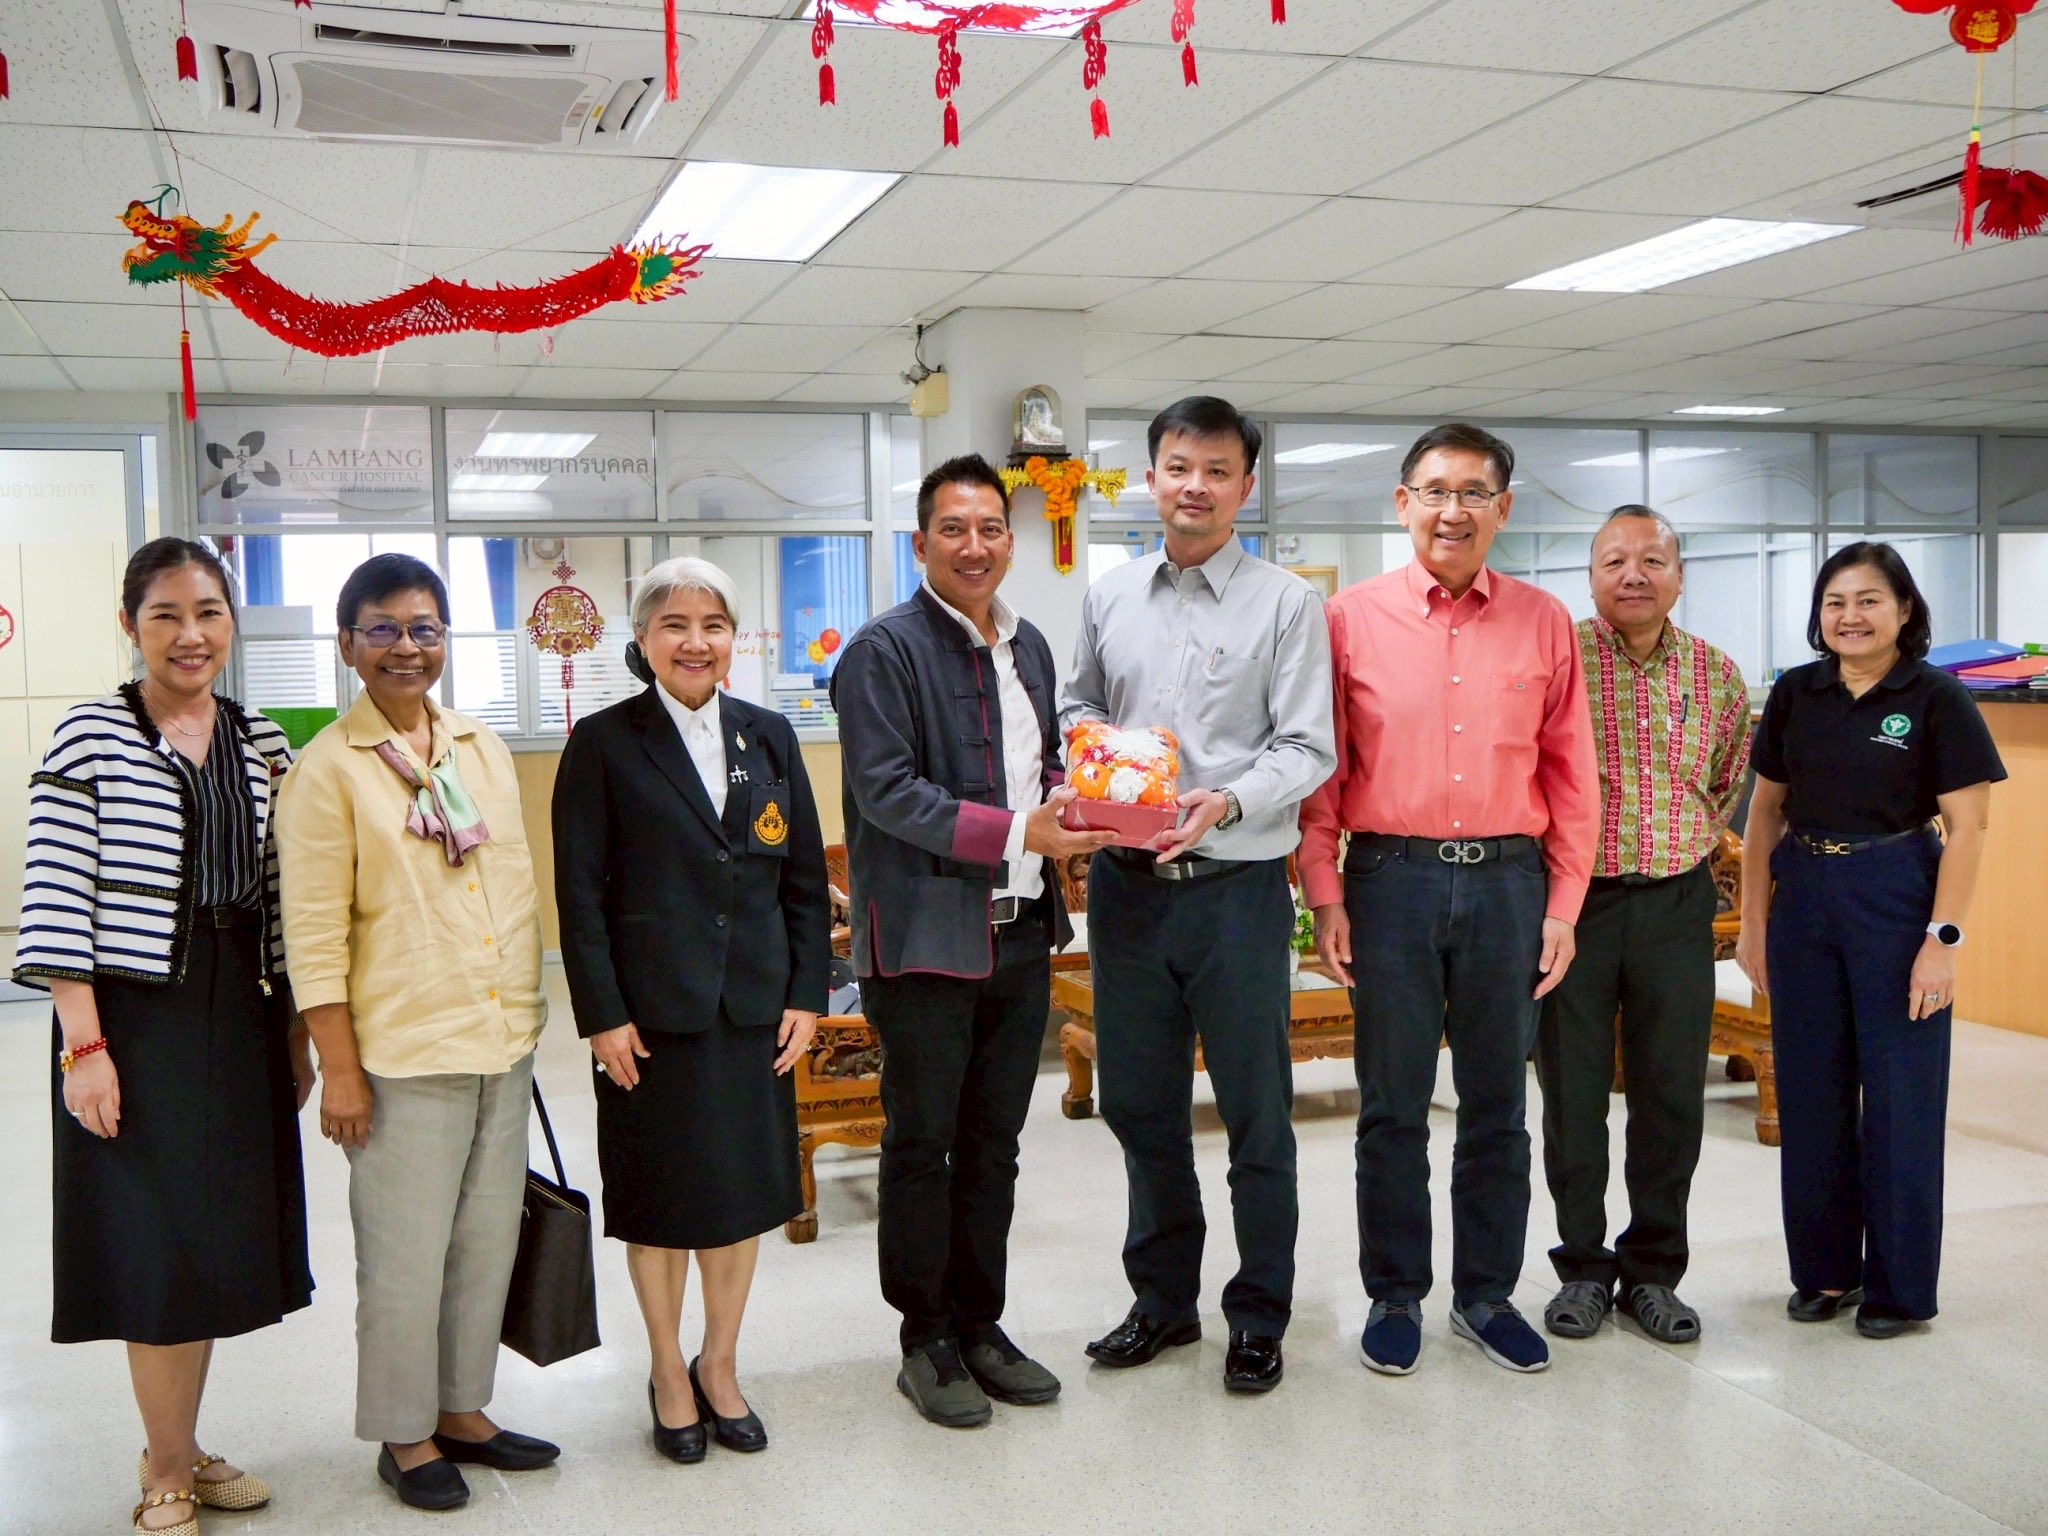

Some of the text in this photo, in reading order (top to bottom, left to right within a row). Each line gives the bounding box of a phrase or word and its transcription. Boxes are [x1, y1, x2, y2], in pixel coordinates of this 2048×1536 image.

[288, 448, 424, 467] LAMPANG
[289, 471, 424, 484] CANCER HOSPITAL
[454, 457, 649, 482] งานทรพยากรบุคคล
